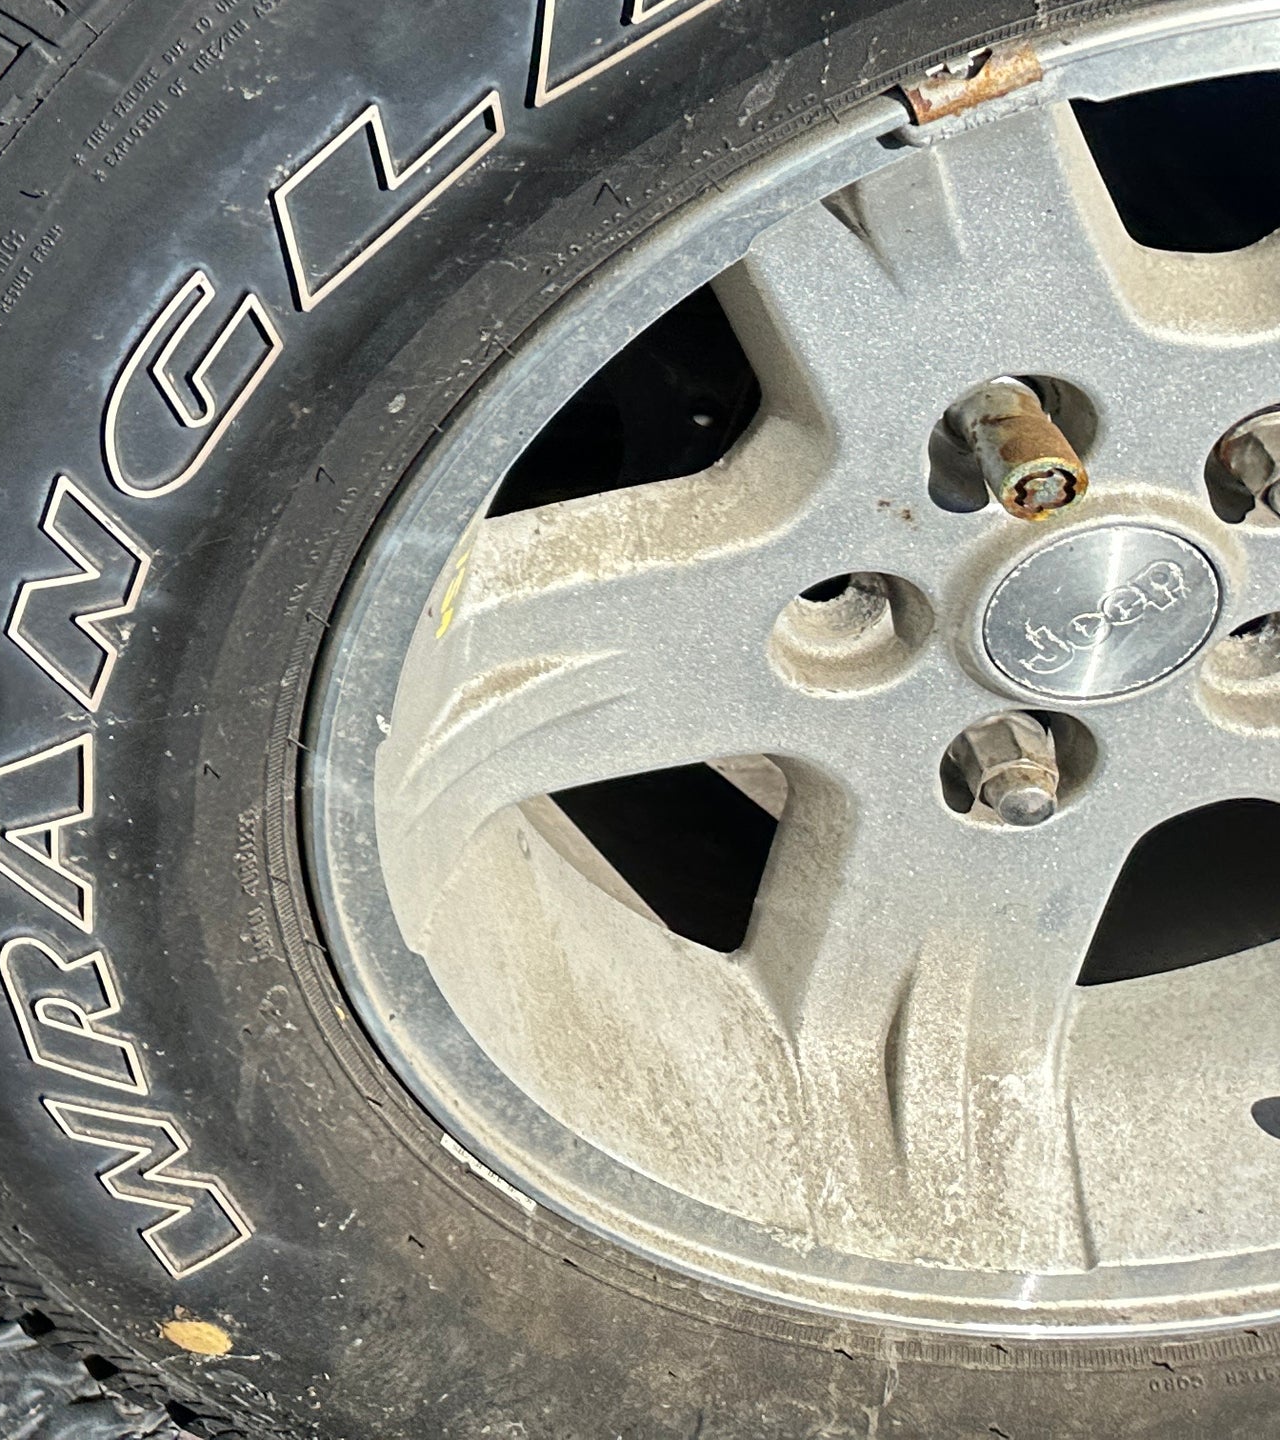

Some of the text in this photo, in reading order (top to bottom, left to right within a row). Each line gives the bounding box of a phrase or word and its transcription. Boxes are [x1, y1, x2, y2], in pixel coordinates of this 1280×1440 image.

[83, 119, 114, 150] TIRE
[112, 66, 160, 118] FAILURE
[161, 37, 187, 65] DUE
[193, 16, 213, 35] TO
[104, 99, 169, 168] EXPLOSION
[167, 76, 188, 98] OF
[1018, 558, 1193, 675] Jeep
